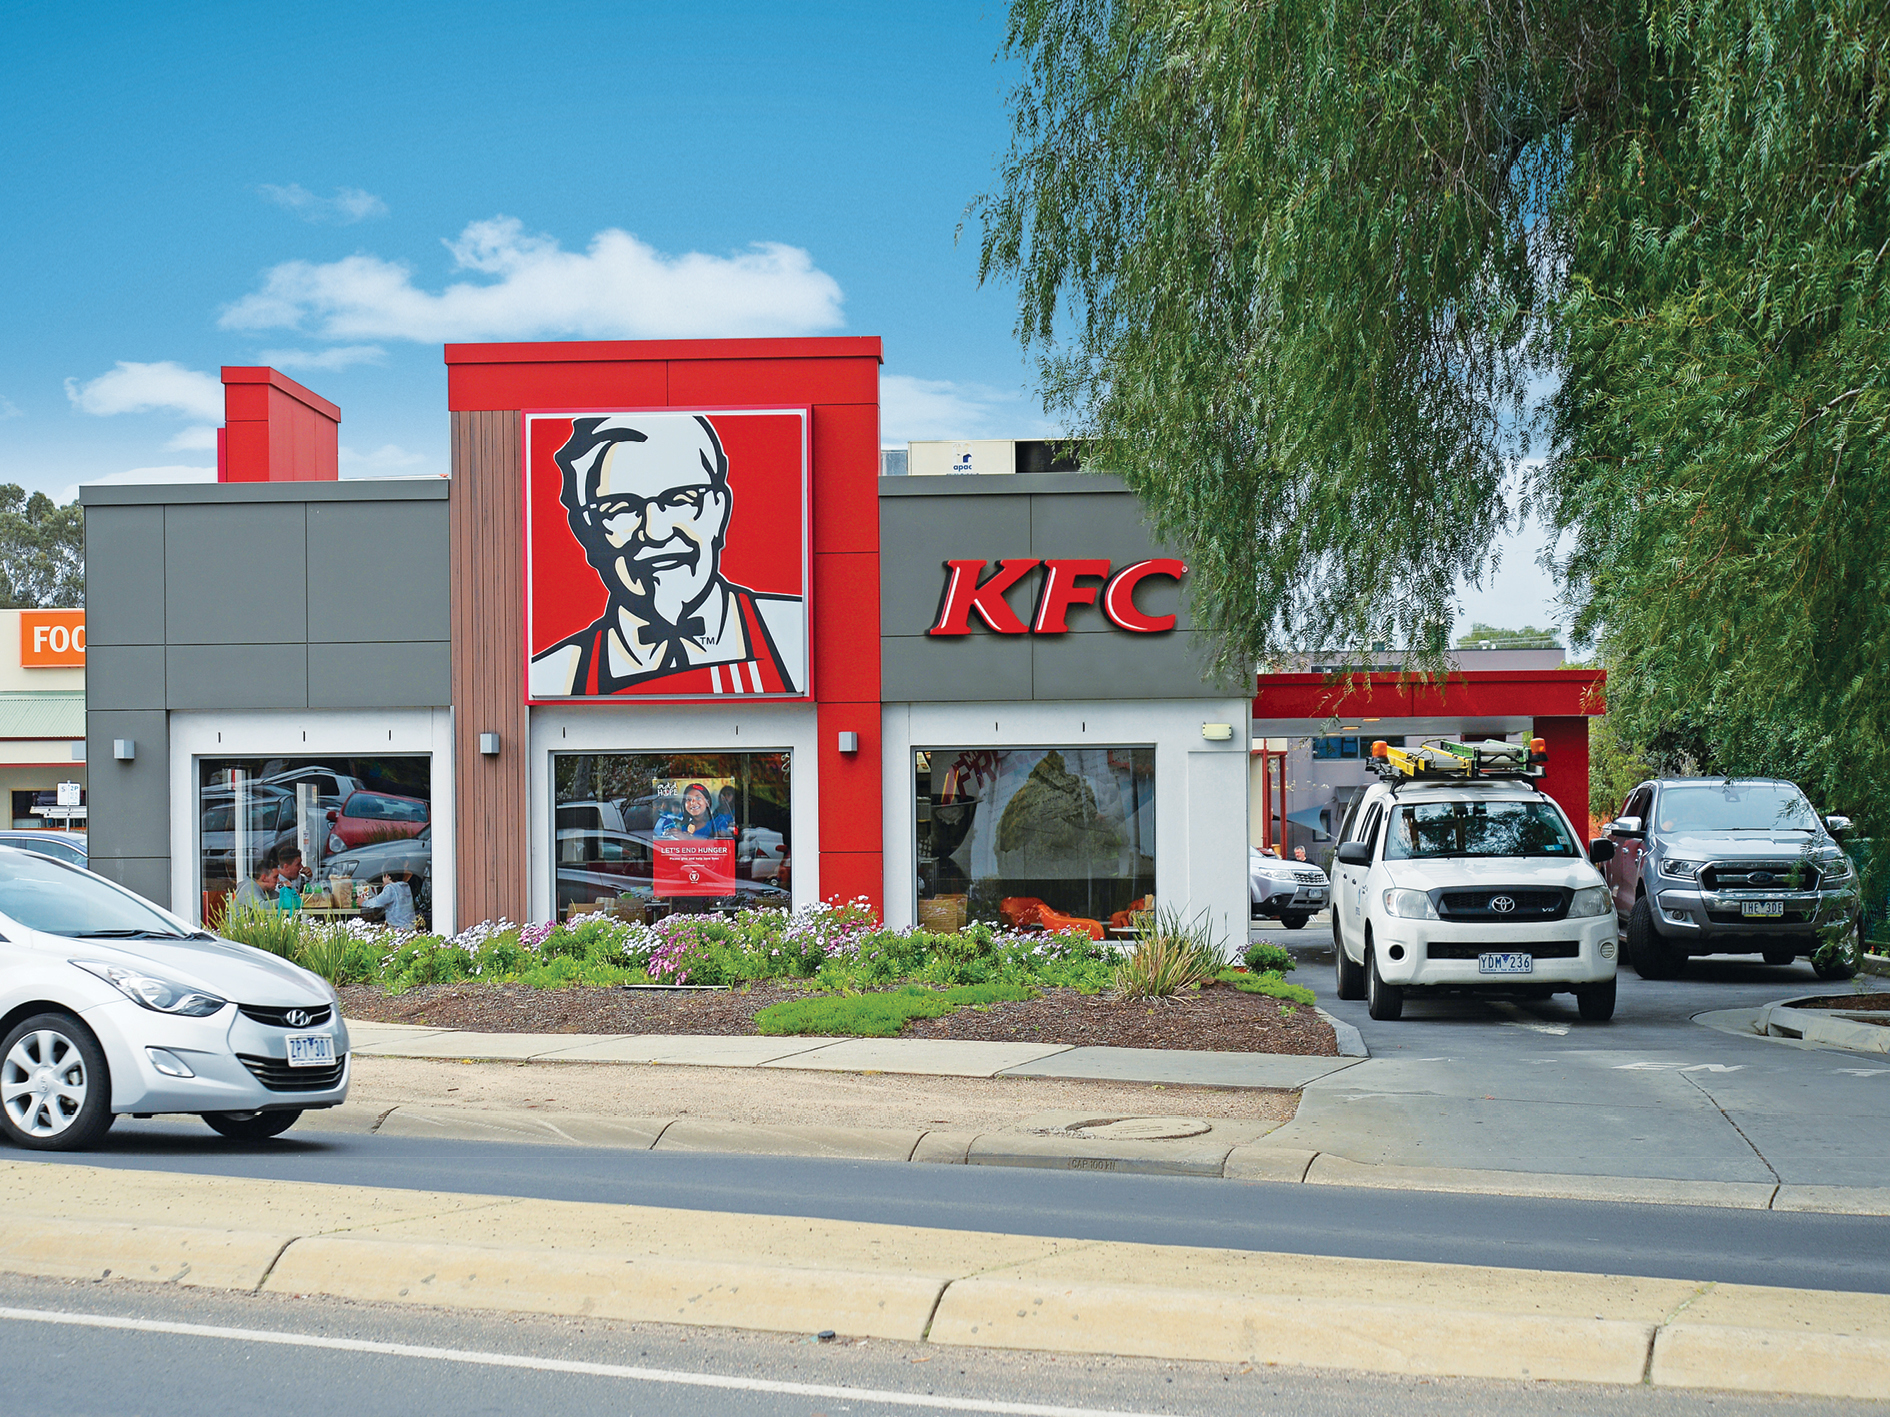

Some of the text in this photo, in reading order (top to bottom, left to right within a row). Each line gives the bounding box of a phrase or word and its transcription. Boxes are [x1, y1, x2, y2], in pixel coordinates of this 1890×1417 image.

[953, 464, 972, 472] apac
[928, 558, 1185, 635] KFC
[699, 636, 714, 645] TM
[1480, 956, 1530, 968] YDM 236
